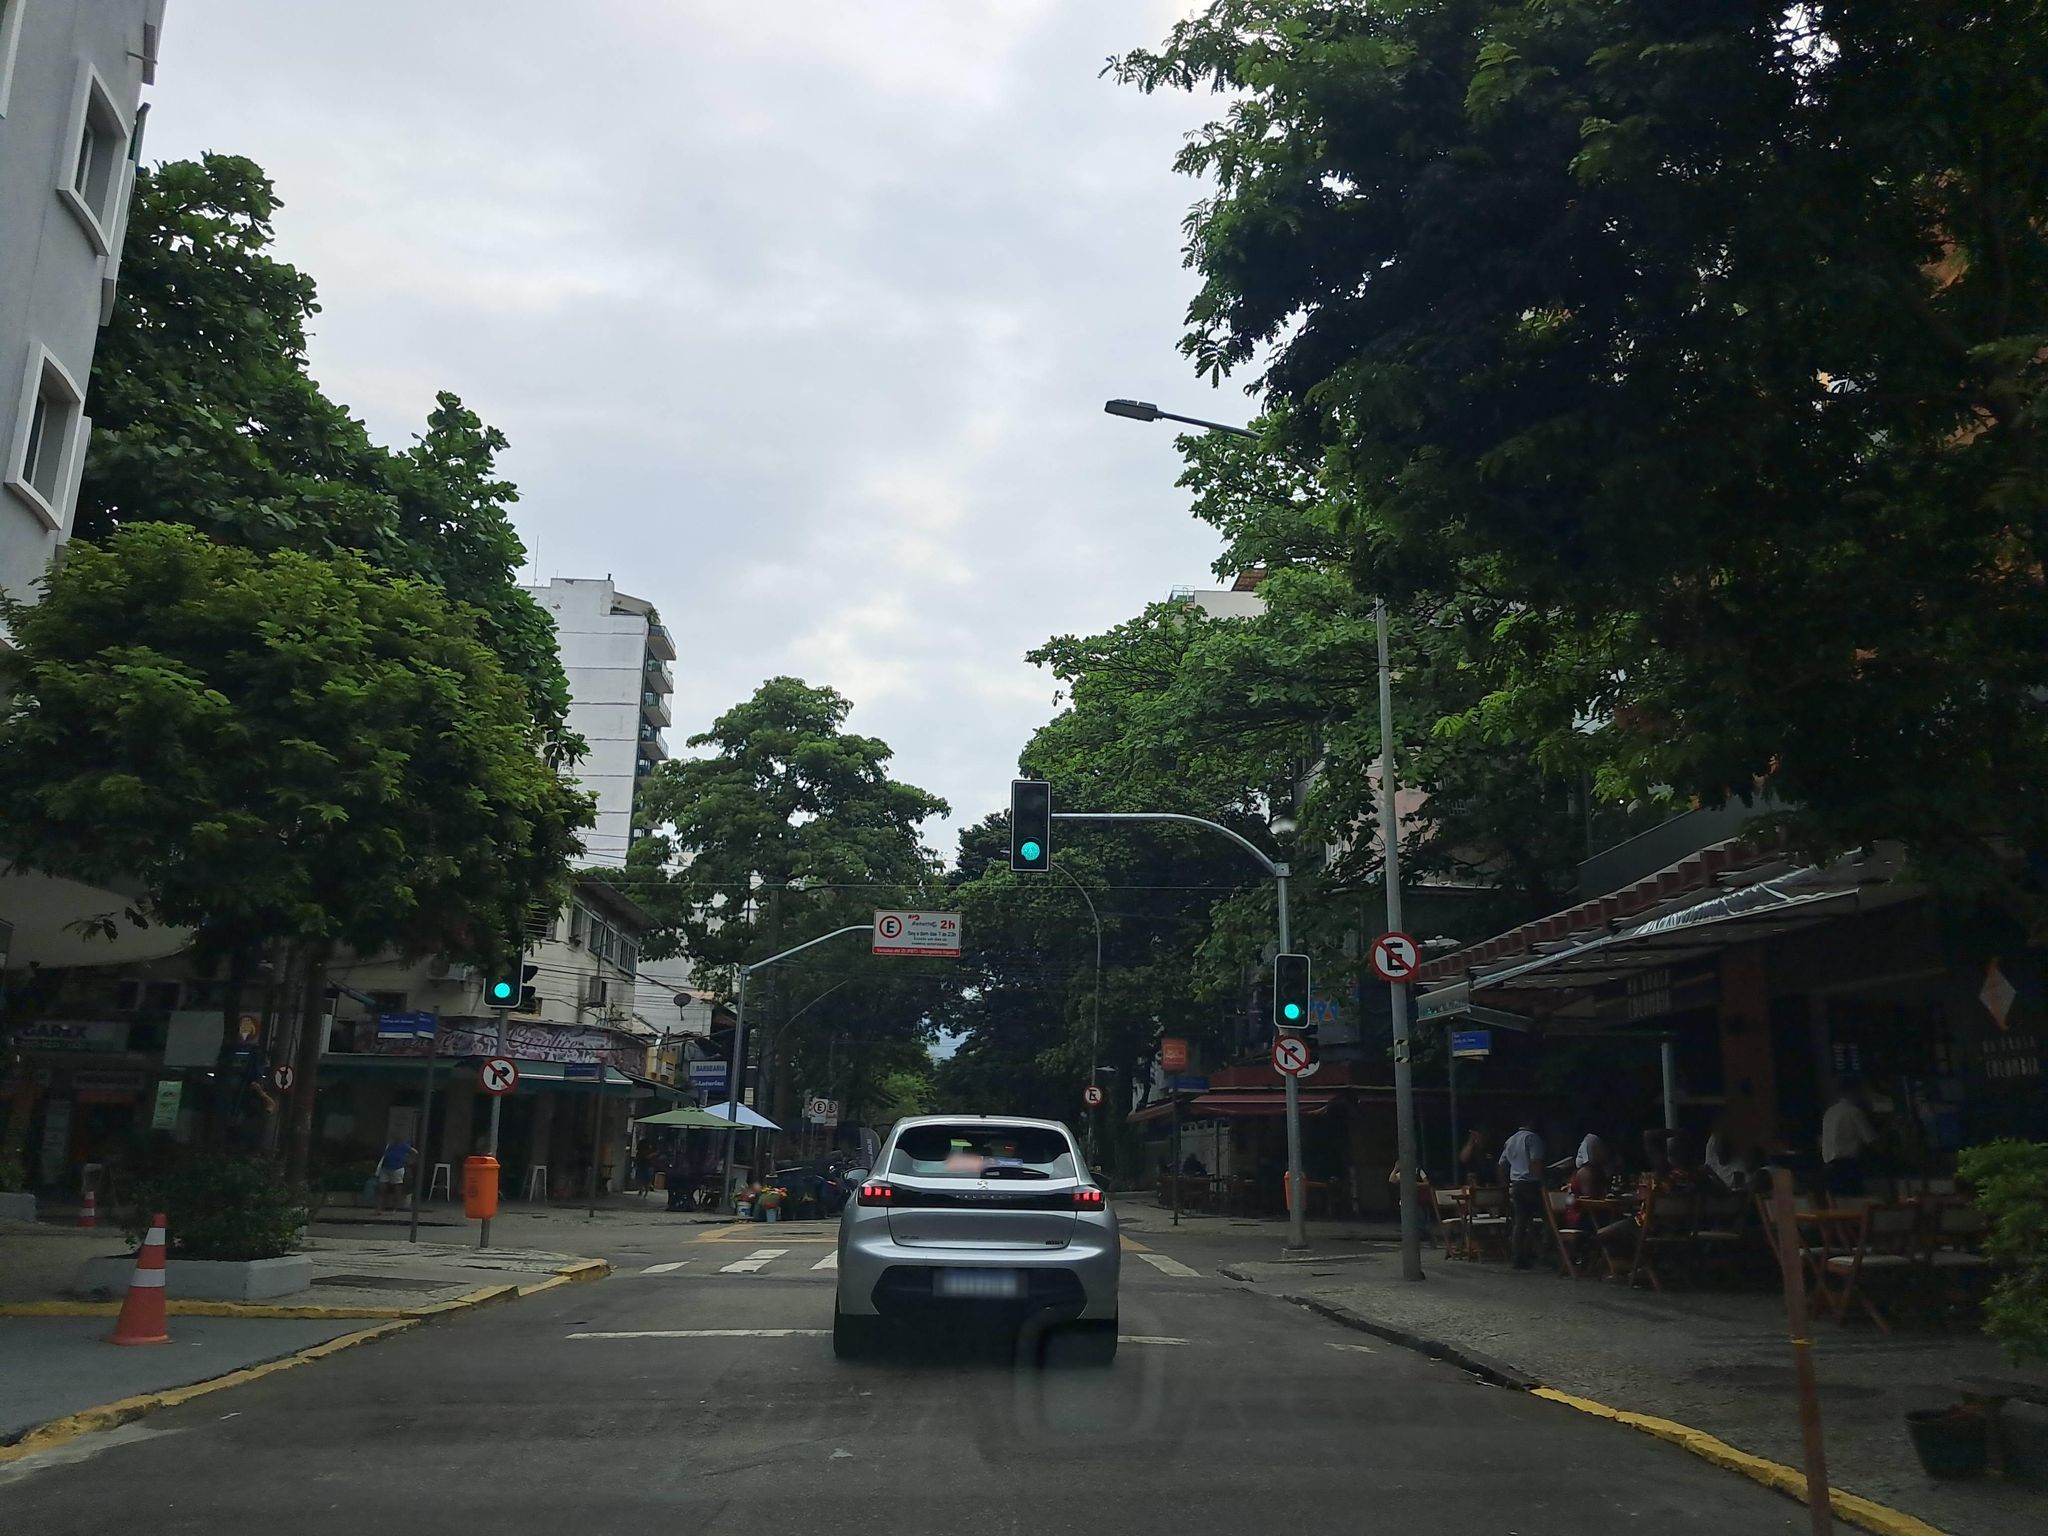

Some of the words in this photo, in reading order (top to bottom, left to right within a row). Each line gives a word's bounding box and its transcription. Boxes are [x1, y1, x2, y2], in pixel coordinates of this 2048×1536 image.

[886, 920, 895, 934] E
[940, 920, 956, 930] 2h
[1386, 942, 1404, 971] E
